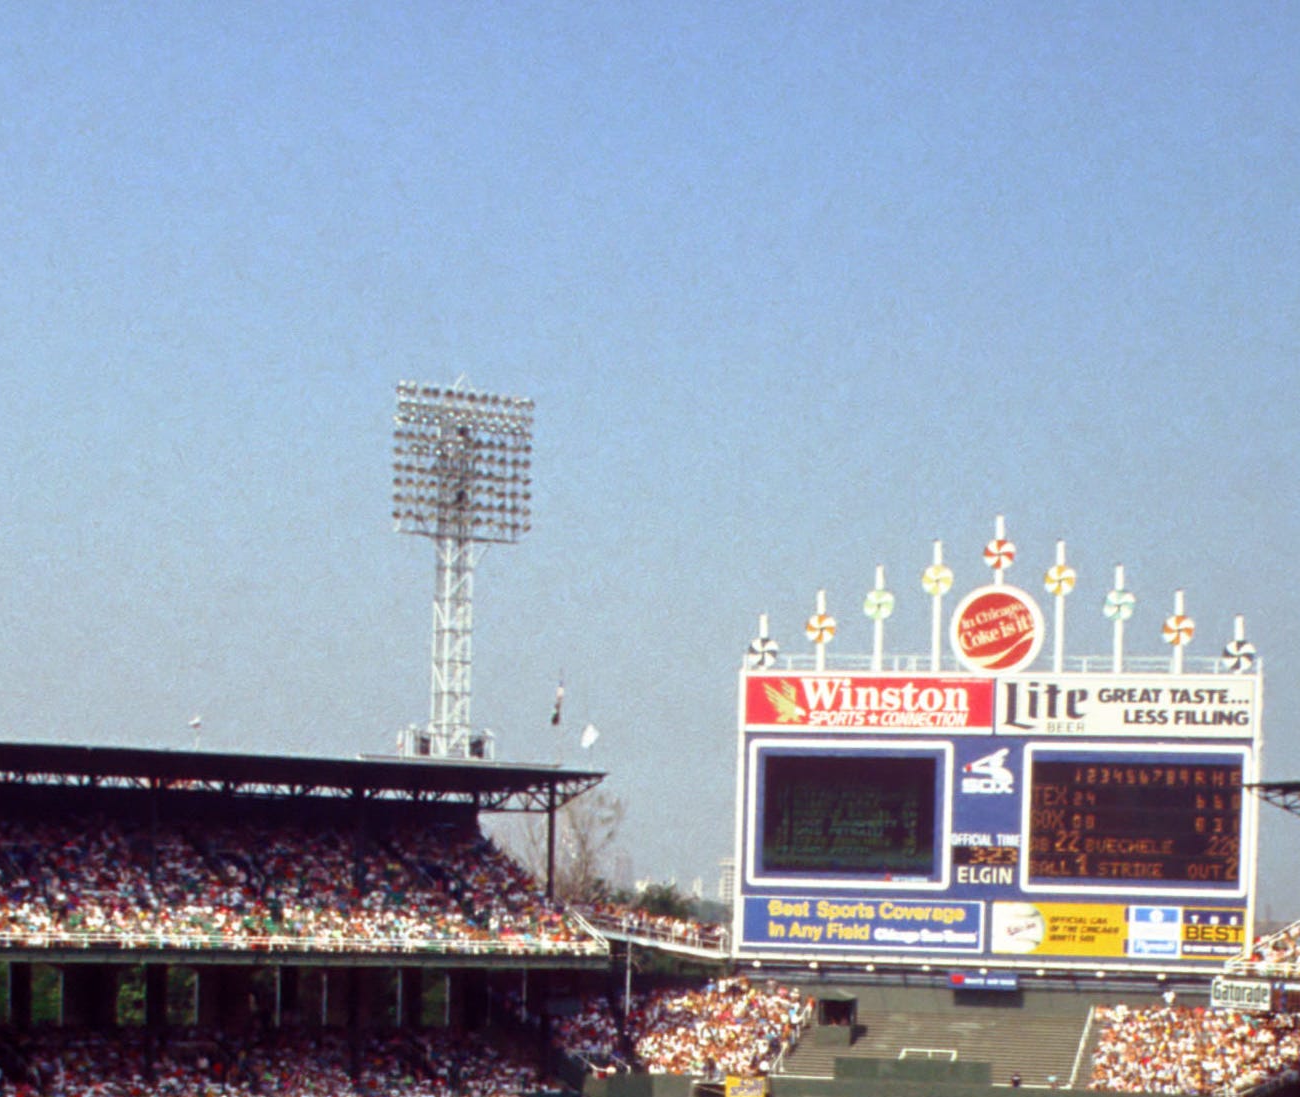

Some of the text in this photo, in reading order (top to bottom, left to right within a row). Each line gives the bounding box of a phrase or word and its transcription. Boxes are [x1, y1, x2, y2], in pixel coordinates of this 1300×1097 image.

[960, 628, 1000, 650] Coke
[999, 620, 1017, 638] is
[800, 677, 969, 712] Winston
[1097, 688, 1249, 705] GREAT TASTE...
[1004, 682, 1088, 730] Lite
[808, 711, 968, 728] SPORTS CONNECTION
[1047, 722, 1085, 733] BEER
[1123, 709, 1249, 727] LESS FILLING
[1033, 785, 1068, 806] TEX
[996, 833, 1022, 847] TIME
[957, 866, 1014, 885] ELGIN
[1098, 861, 1165, 877] STRIKE
[1187, 863, 1223, 880] OUT
[768, 900, 966, 924] Best Sports Coverage
[768, 921, 870, 942] In Any Field
[1186, 926, 1244, 940] BEST
[1213, 980, 1270, 1003] Gatorade
